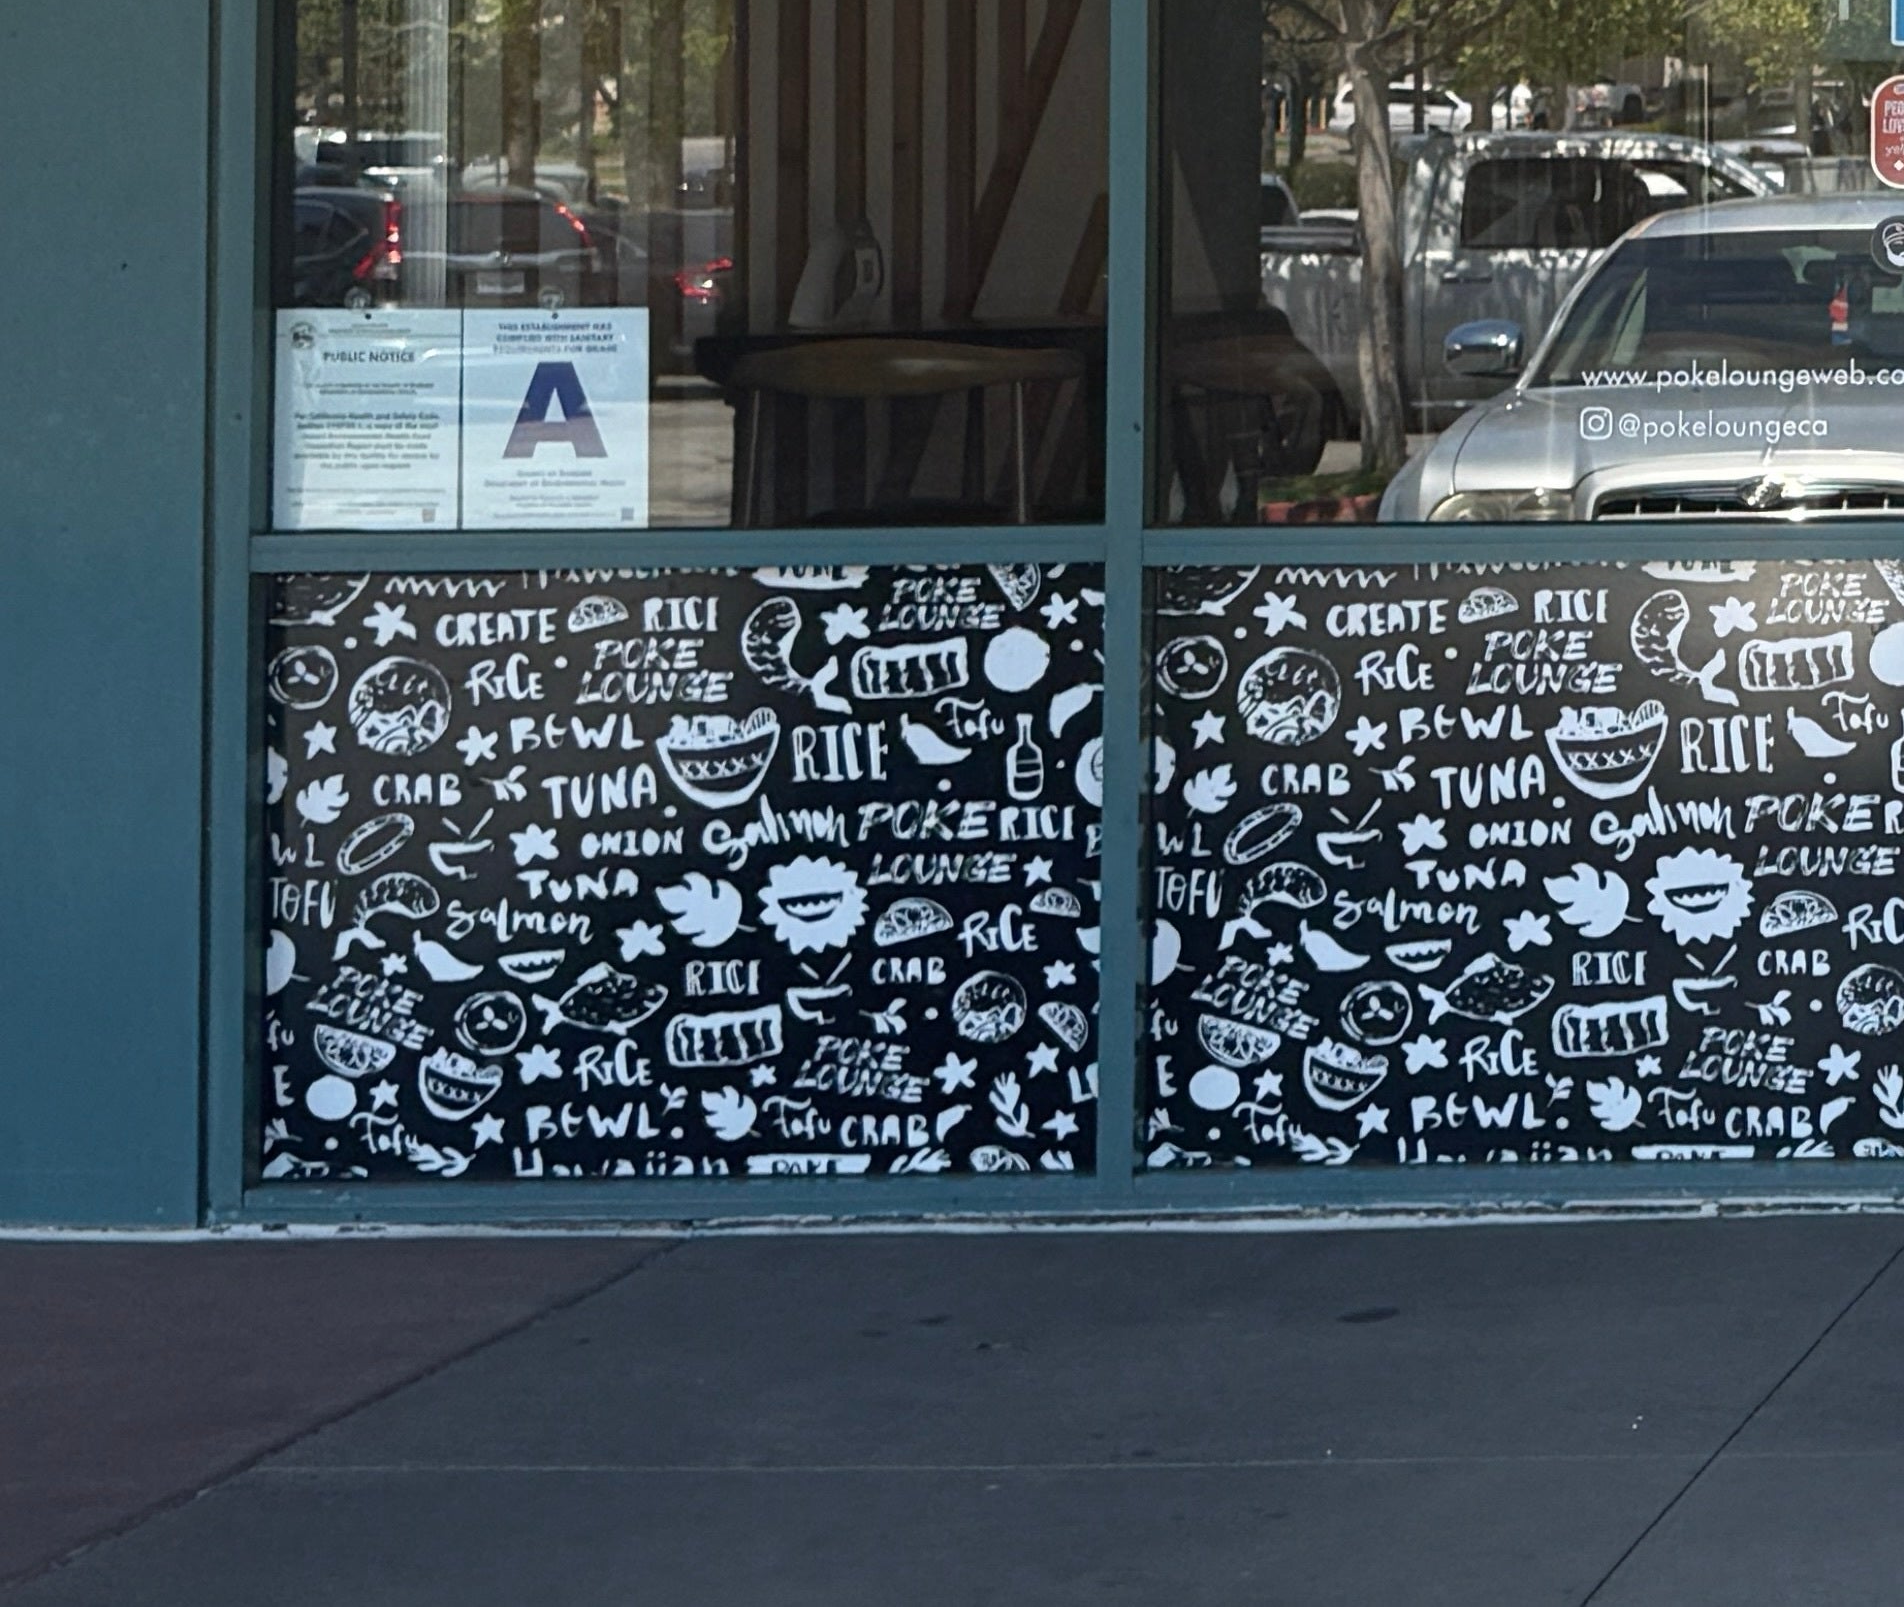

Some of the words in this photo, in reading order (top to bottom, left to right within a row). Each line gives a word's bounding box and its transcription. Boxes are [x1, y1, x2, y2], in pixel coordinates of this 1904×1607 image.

[323, 351, 366, 363] PUBLIC
[369, 351, 415, 363] NOTICE
[502, 361, 608, 459] A
[1619, 411, 1828, 444] @pokeloungeca
[436, 608, 557, 646] CREATE
[1326, 600, 1448, 637] CREATE
[595, 638, 703, 670] POKE
[1485, 629, 1593, 661] POKE
[465, 653, 544, 706] RICE
[1355, 644, 1434, 695] RICE
[1466, 661, 1622, 695] LOUNGE
[576, 670, 733, 704] LOUNGE
[792, 721, 888, 781] RICE
[1681, 714, 1774, 773] RICE
[374, 774, 461, 806] CRAB
[542, 763, 656, 819] TUNA
[1262, 764, 1350, 795] CRAB
[1431, 755, 1545, 809] TUNA
[858, 800, 996, 840] POKE
[1745, 793, 1880, 833] POKE
[867, 852, 1016, 885] LOUNGE
[1413, 858, 1526, 892] TUNA
[1754, 845, 1900, 876] LOUNGE
[525, 868, 638, 902] TUNA
[446, 898, 592, 944] Salmon
[1333, 888, 1479, 934] Salmon
[958, 904, 1038, 957] RICE
[872, 957, 946, 984] CRAB
[1758, 950, 1830, 976] CRAB
[841, 1115, 929, 1147] CRAB
[1725, 1106, 1813, 1138] CRAB
